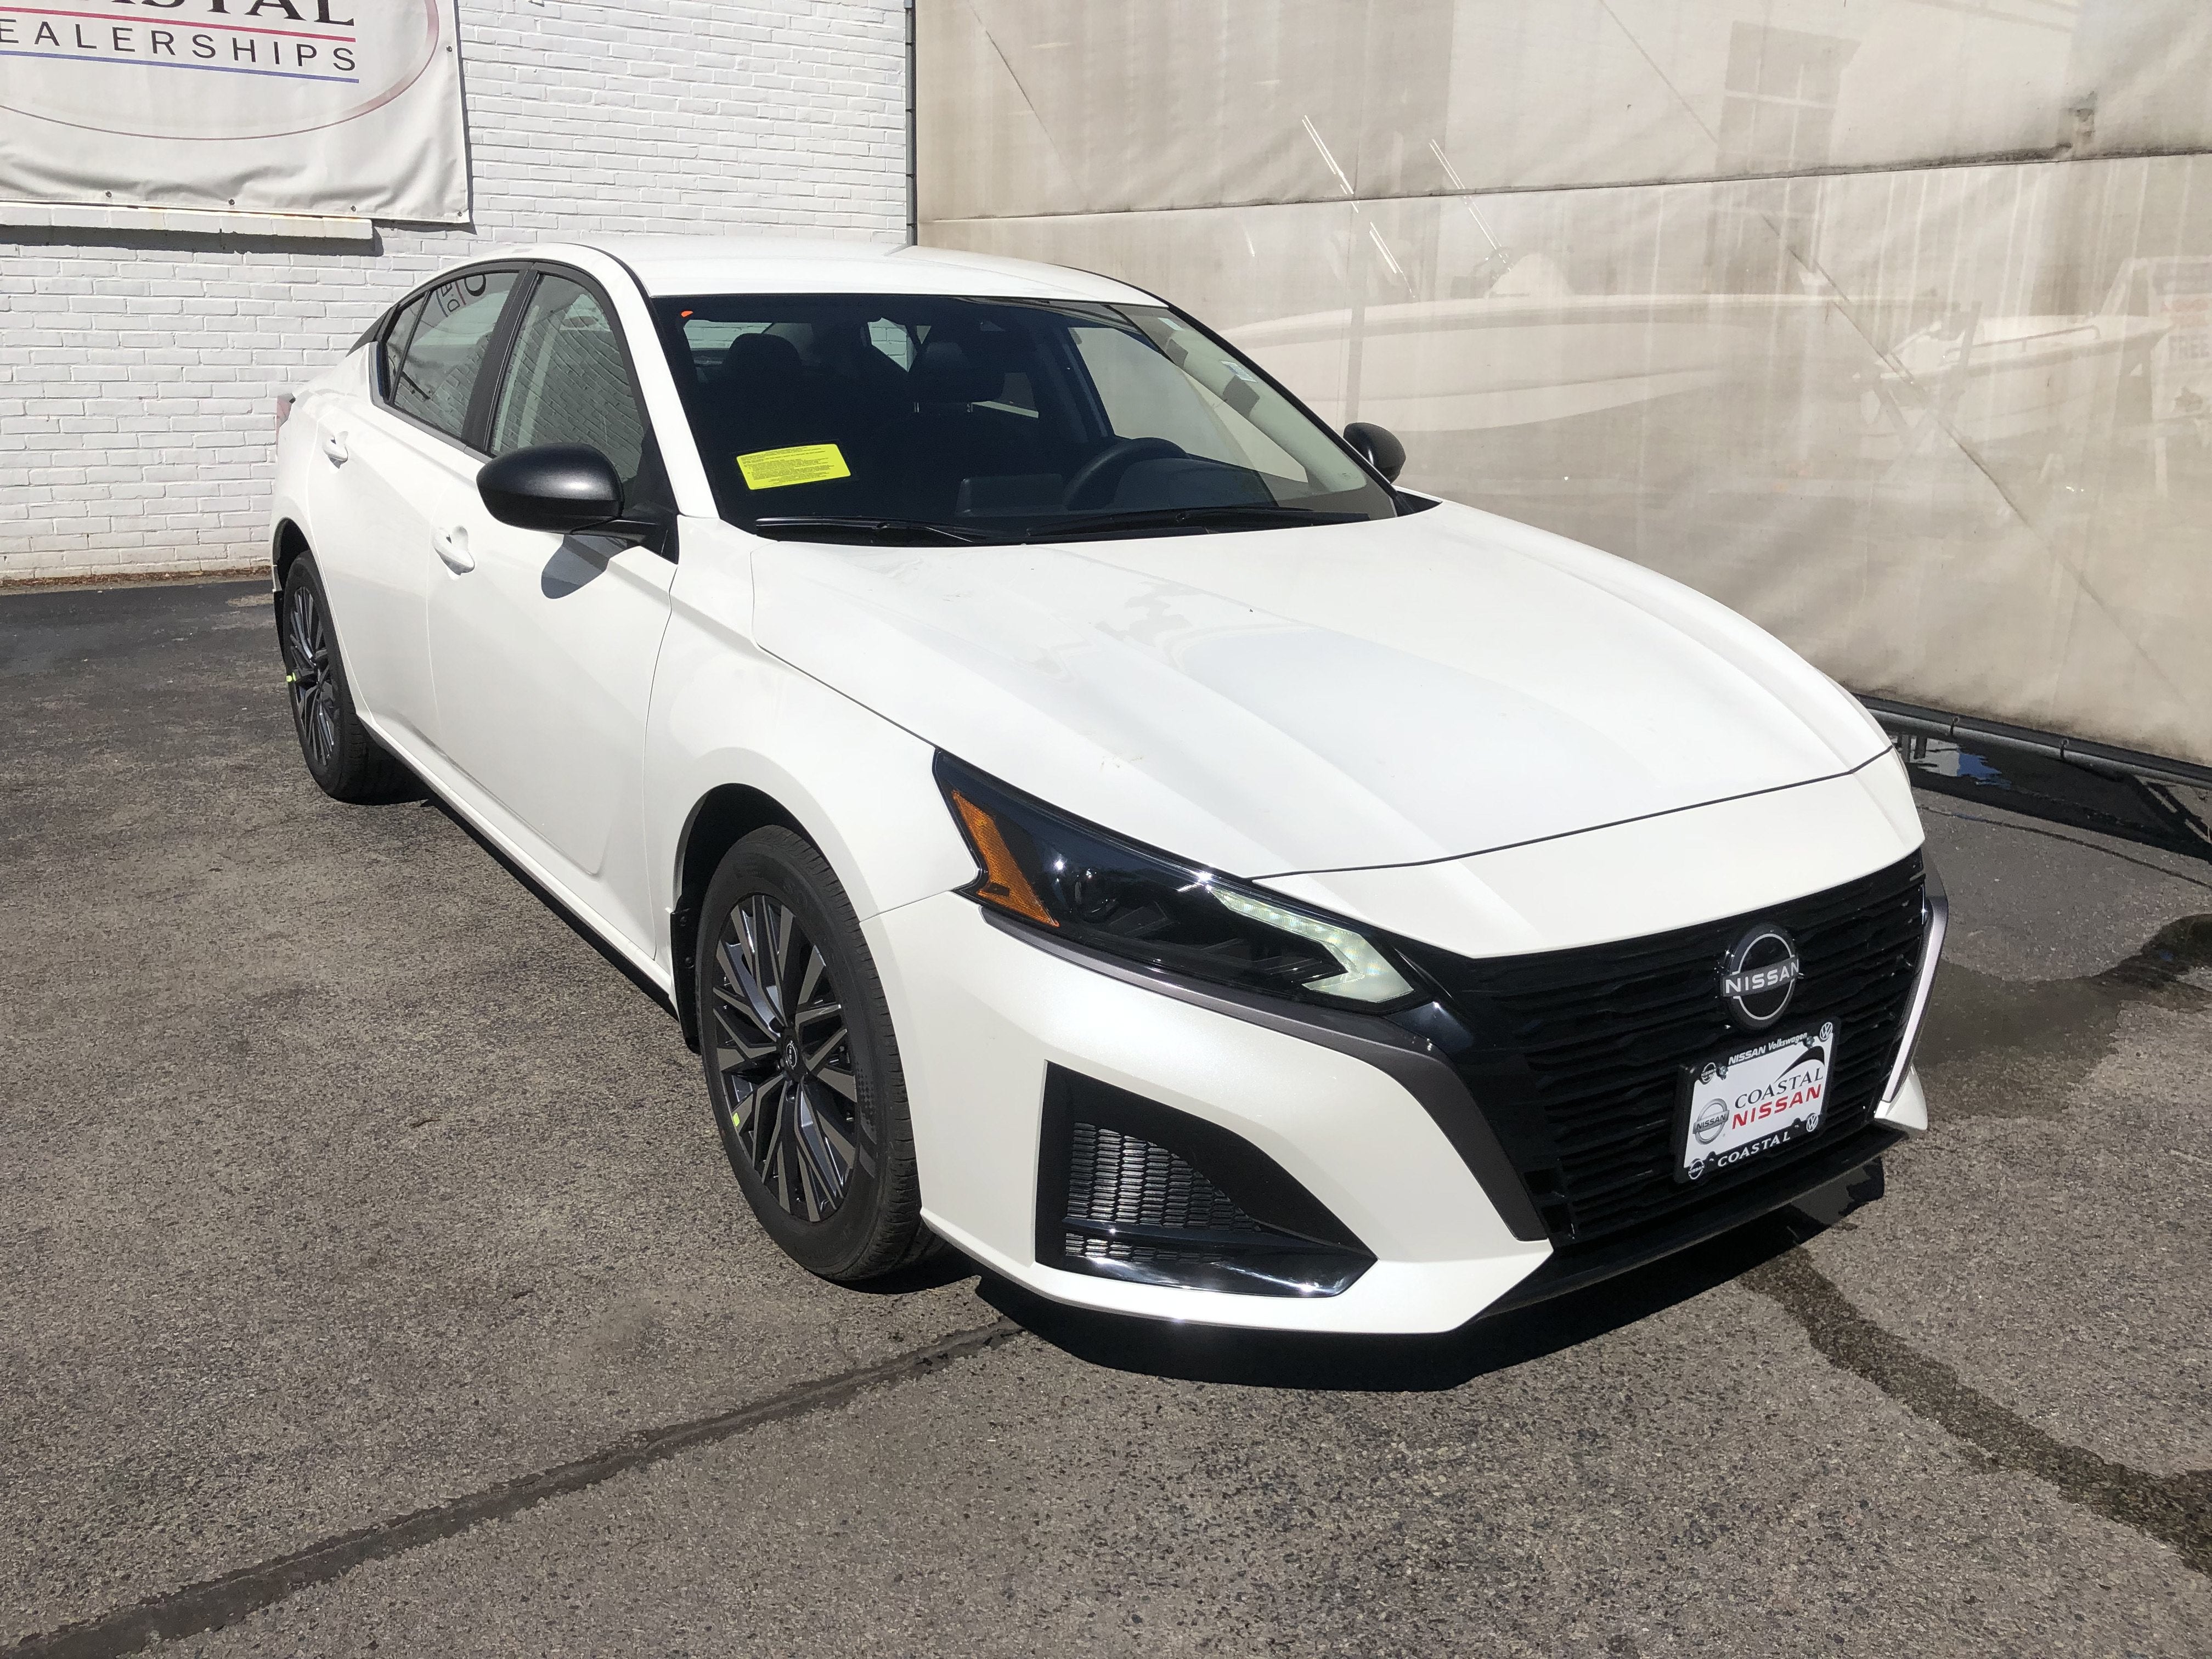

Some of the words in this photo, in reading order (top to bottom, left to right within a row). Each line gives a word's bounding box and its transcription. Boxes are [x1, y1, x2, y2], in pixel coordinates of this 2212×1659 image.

[1725, 958, 1799, 994] NISSAN
[1728, 1045, 1767, 1065] NISSAN
[1768, 1032, 1808, 1051] Volkswagen
[1734, 1067, 1824, 1109] COASTAL
[1696, 1113, 1726, 1130] NISSAN
[1731, 1084, 1821, 1130] NISSAN
[1718, 1131, 1791, 1167] COASTAL
